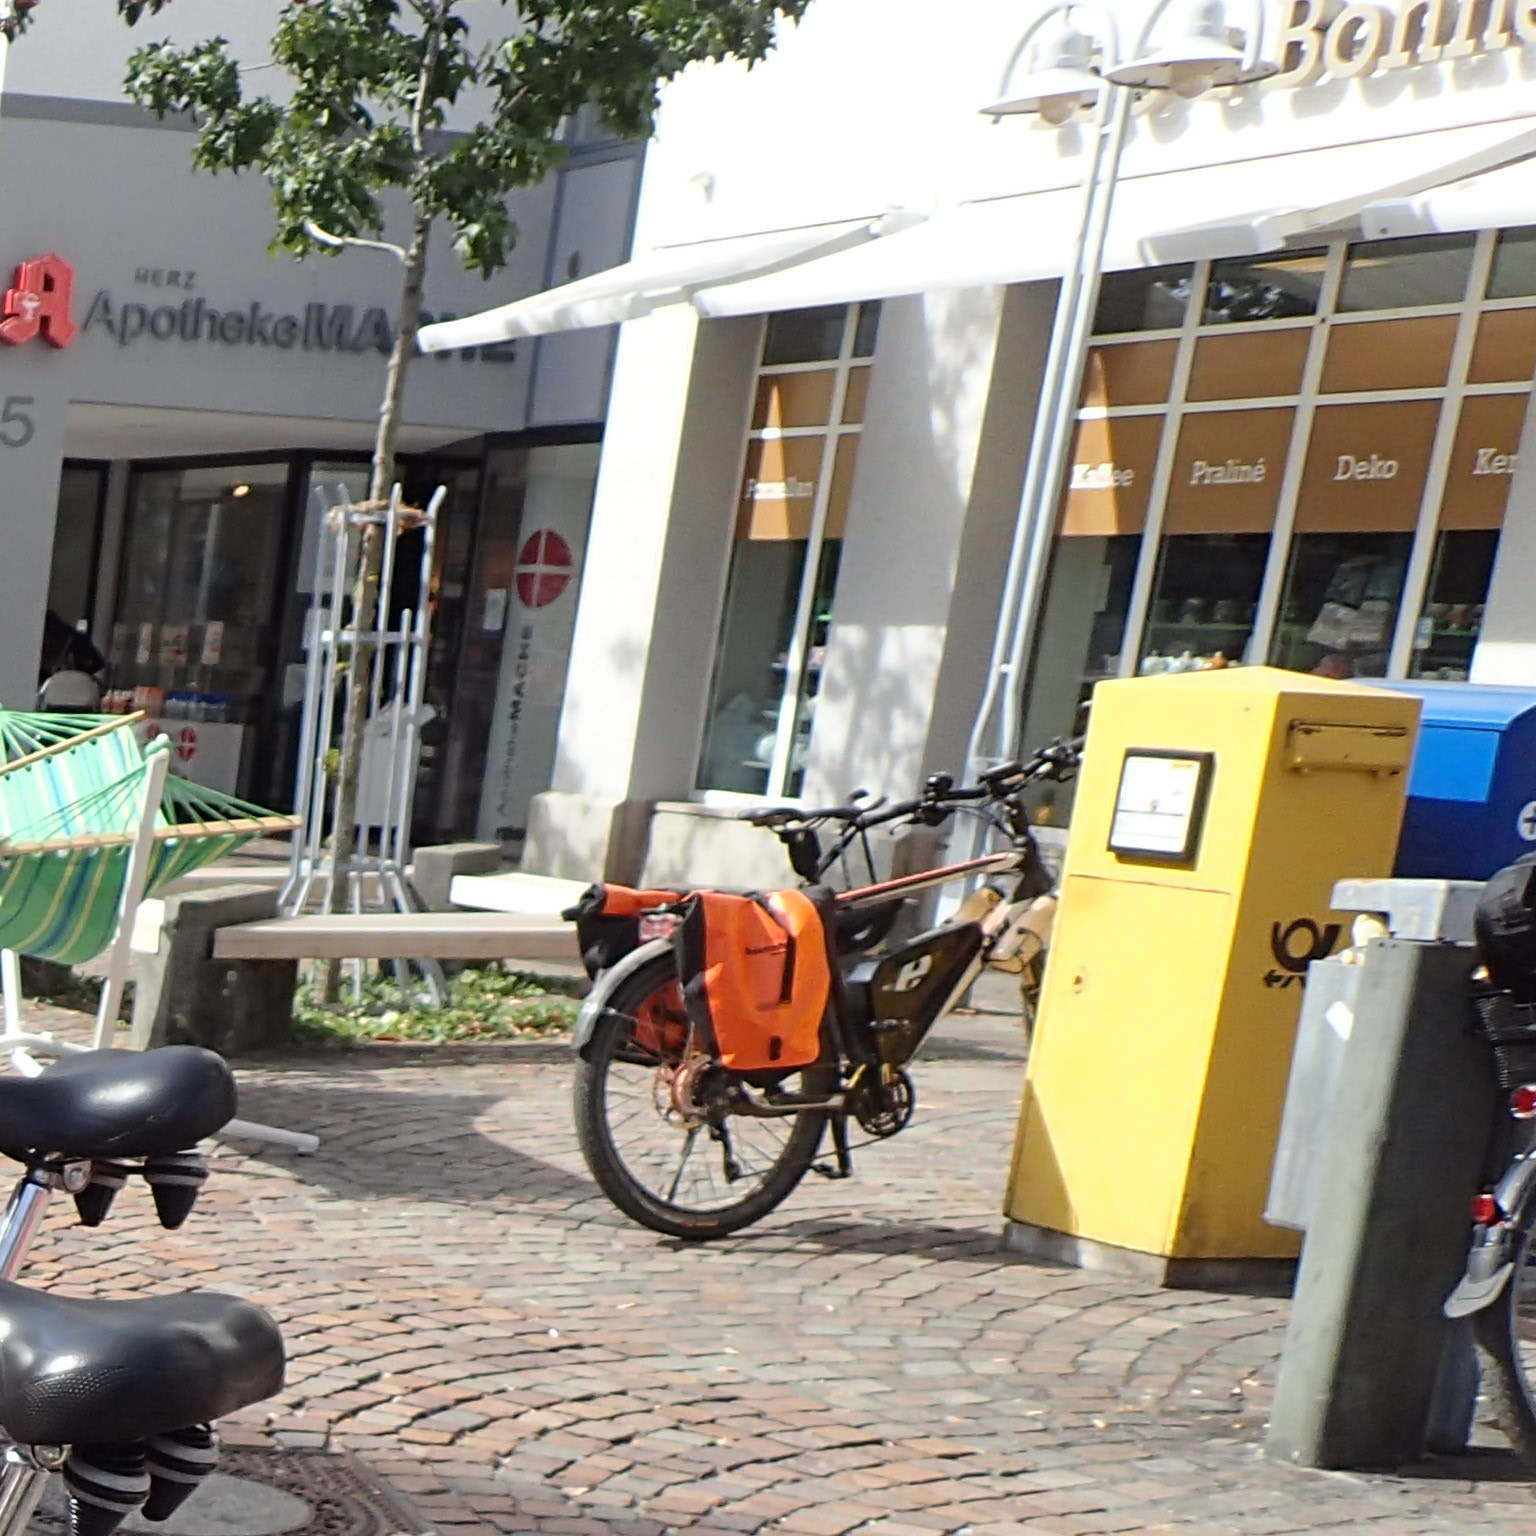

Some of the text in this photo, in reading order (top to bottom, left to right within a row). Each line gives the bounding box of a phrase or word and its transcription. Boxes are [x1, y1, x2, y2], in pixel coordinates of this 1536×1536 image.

[134, 266, 197, 291] HERZ
[1190, 457, 1267, 485] Praliné
[1332, 454, 1399, 481] Deko
